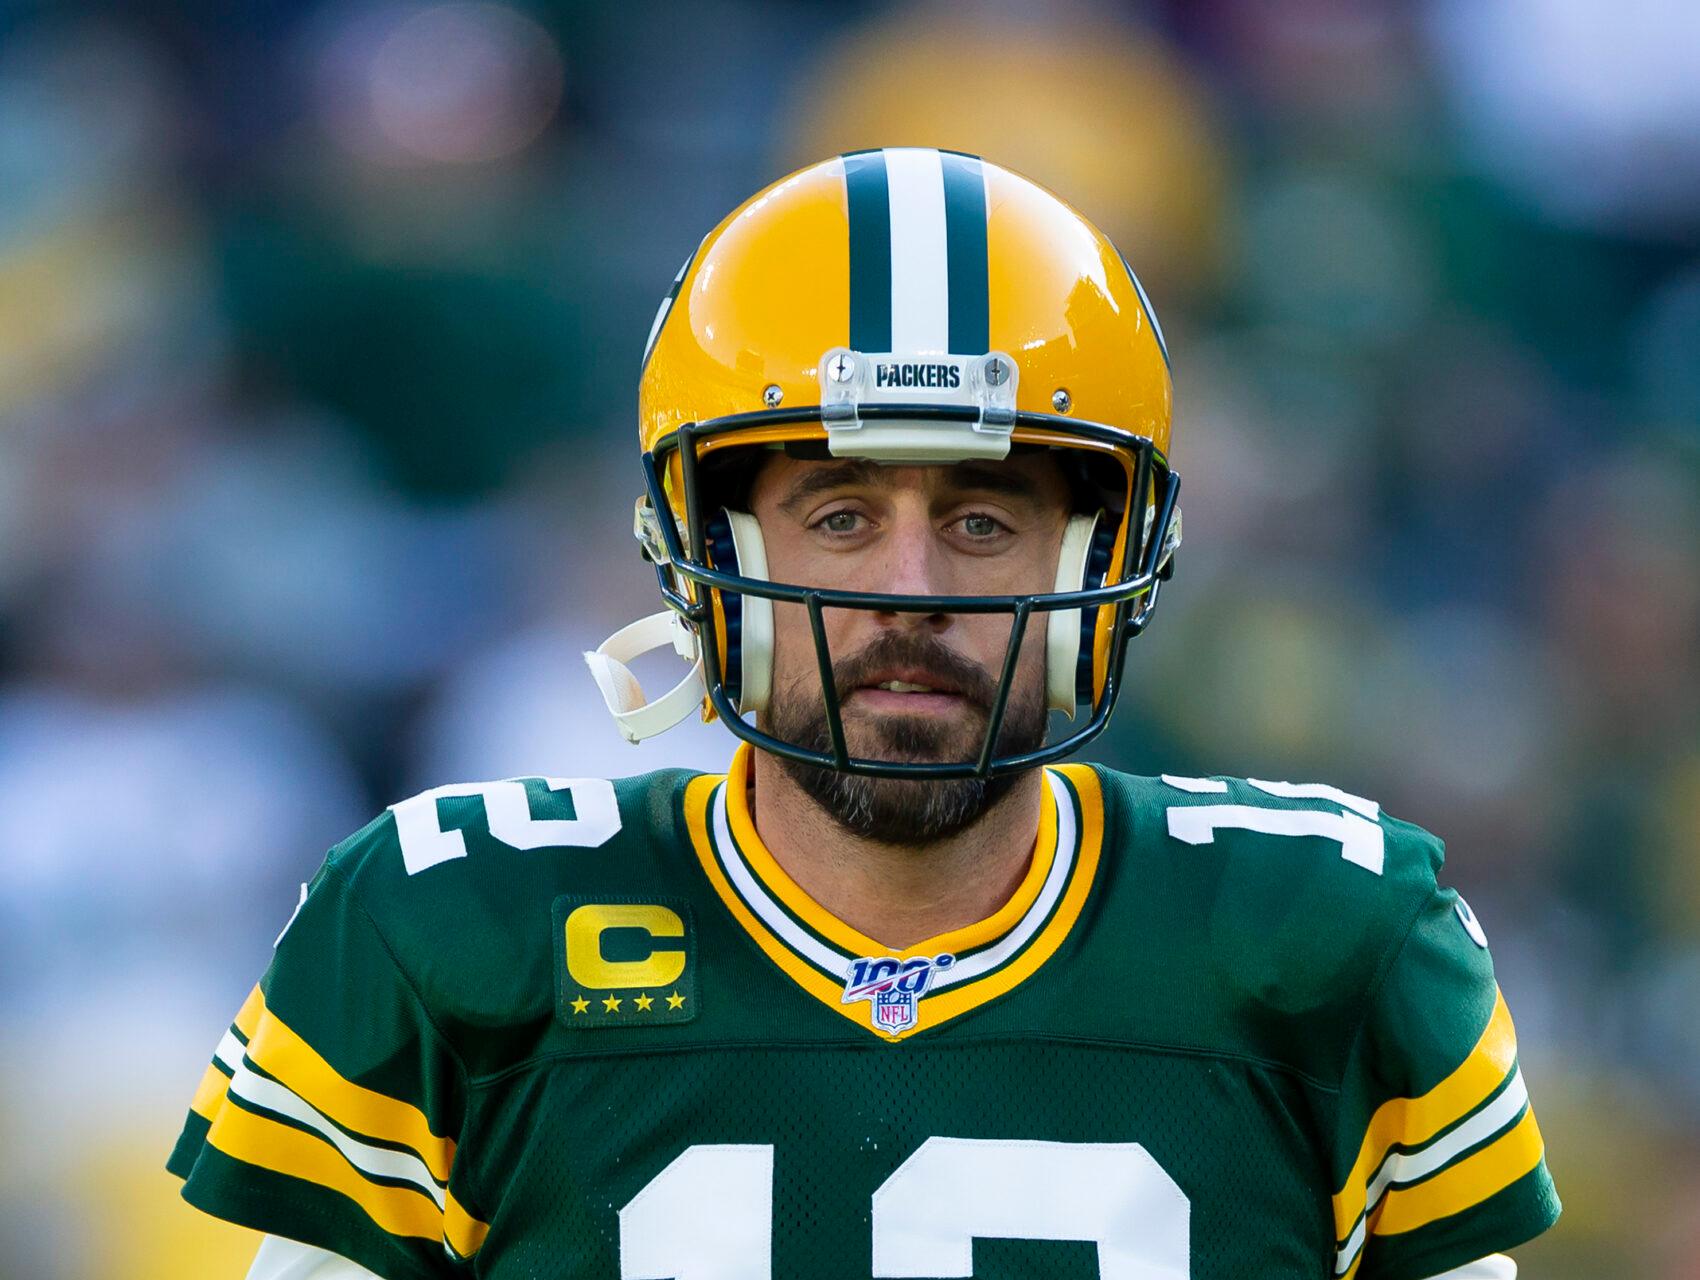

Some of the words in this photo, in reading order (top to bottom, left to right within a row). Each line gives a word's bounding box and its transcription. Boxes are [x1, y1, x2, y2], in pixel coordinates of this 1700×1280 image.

[876, 364, 960, 388] PACKERS
[565, 904, 686, 990] C
[881, 1005, 909, 1024] NFL
